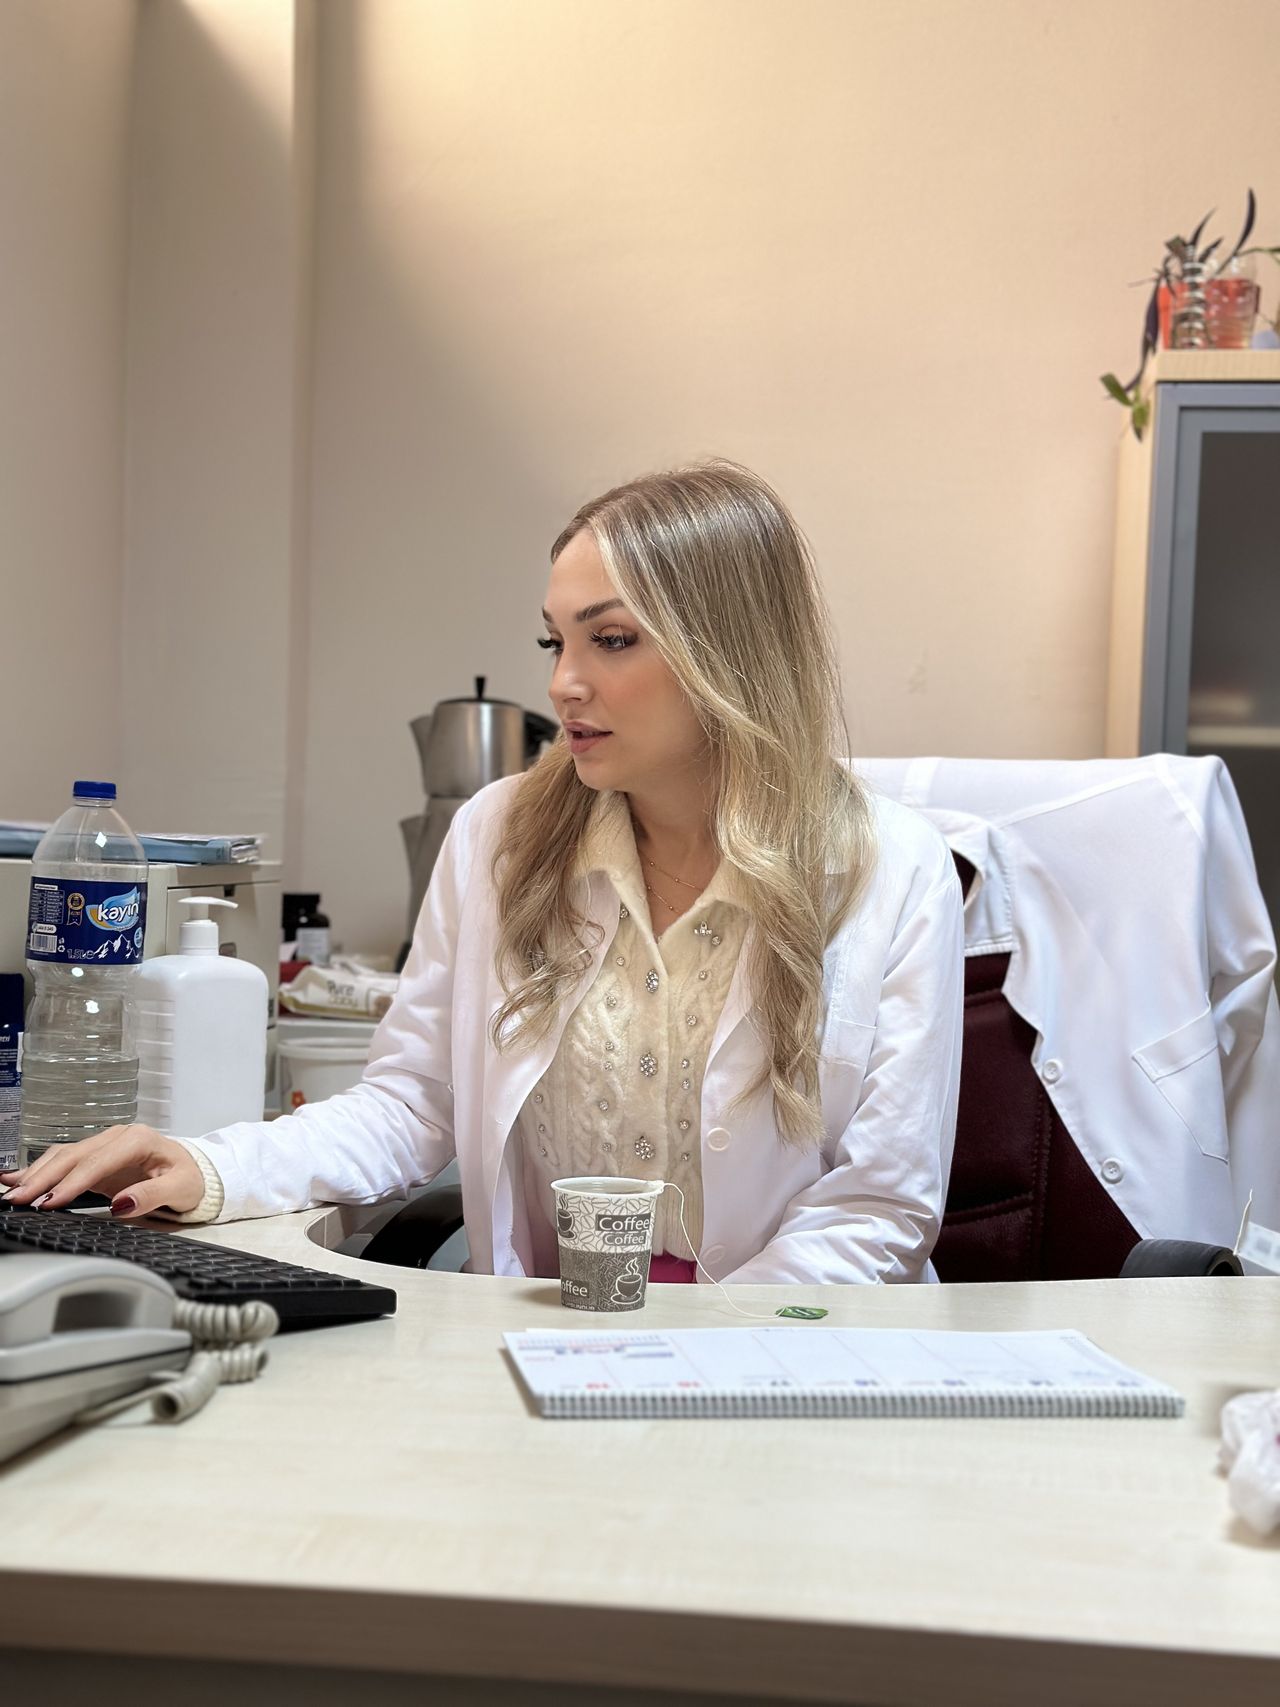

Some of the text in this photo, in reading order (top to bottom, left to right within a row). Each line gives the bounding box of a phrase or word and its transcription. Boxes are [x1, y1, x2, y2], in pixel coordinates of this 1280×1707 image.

[599, 1217, 650, 1230] Coffee
[604, 1234, 644, 1245] Coffee
[562, 1280, 588, 1297] offee
